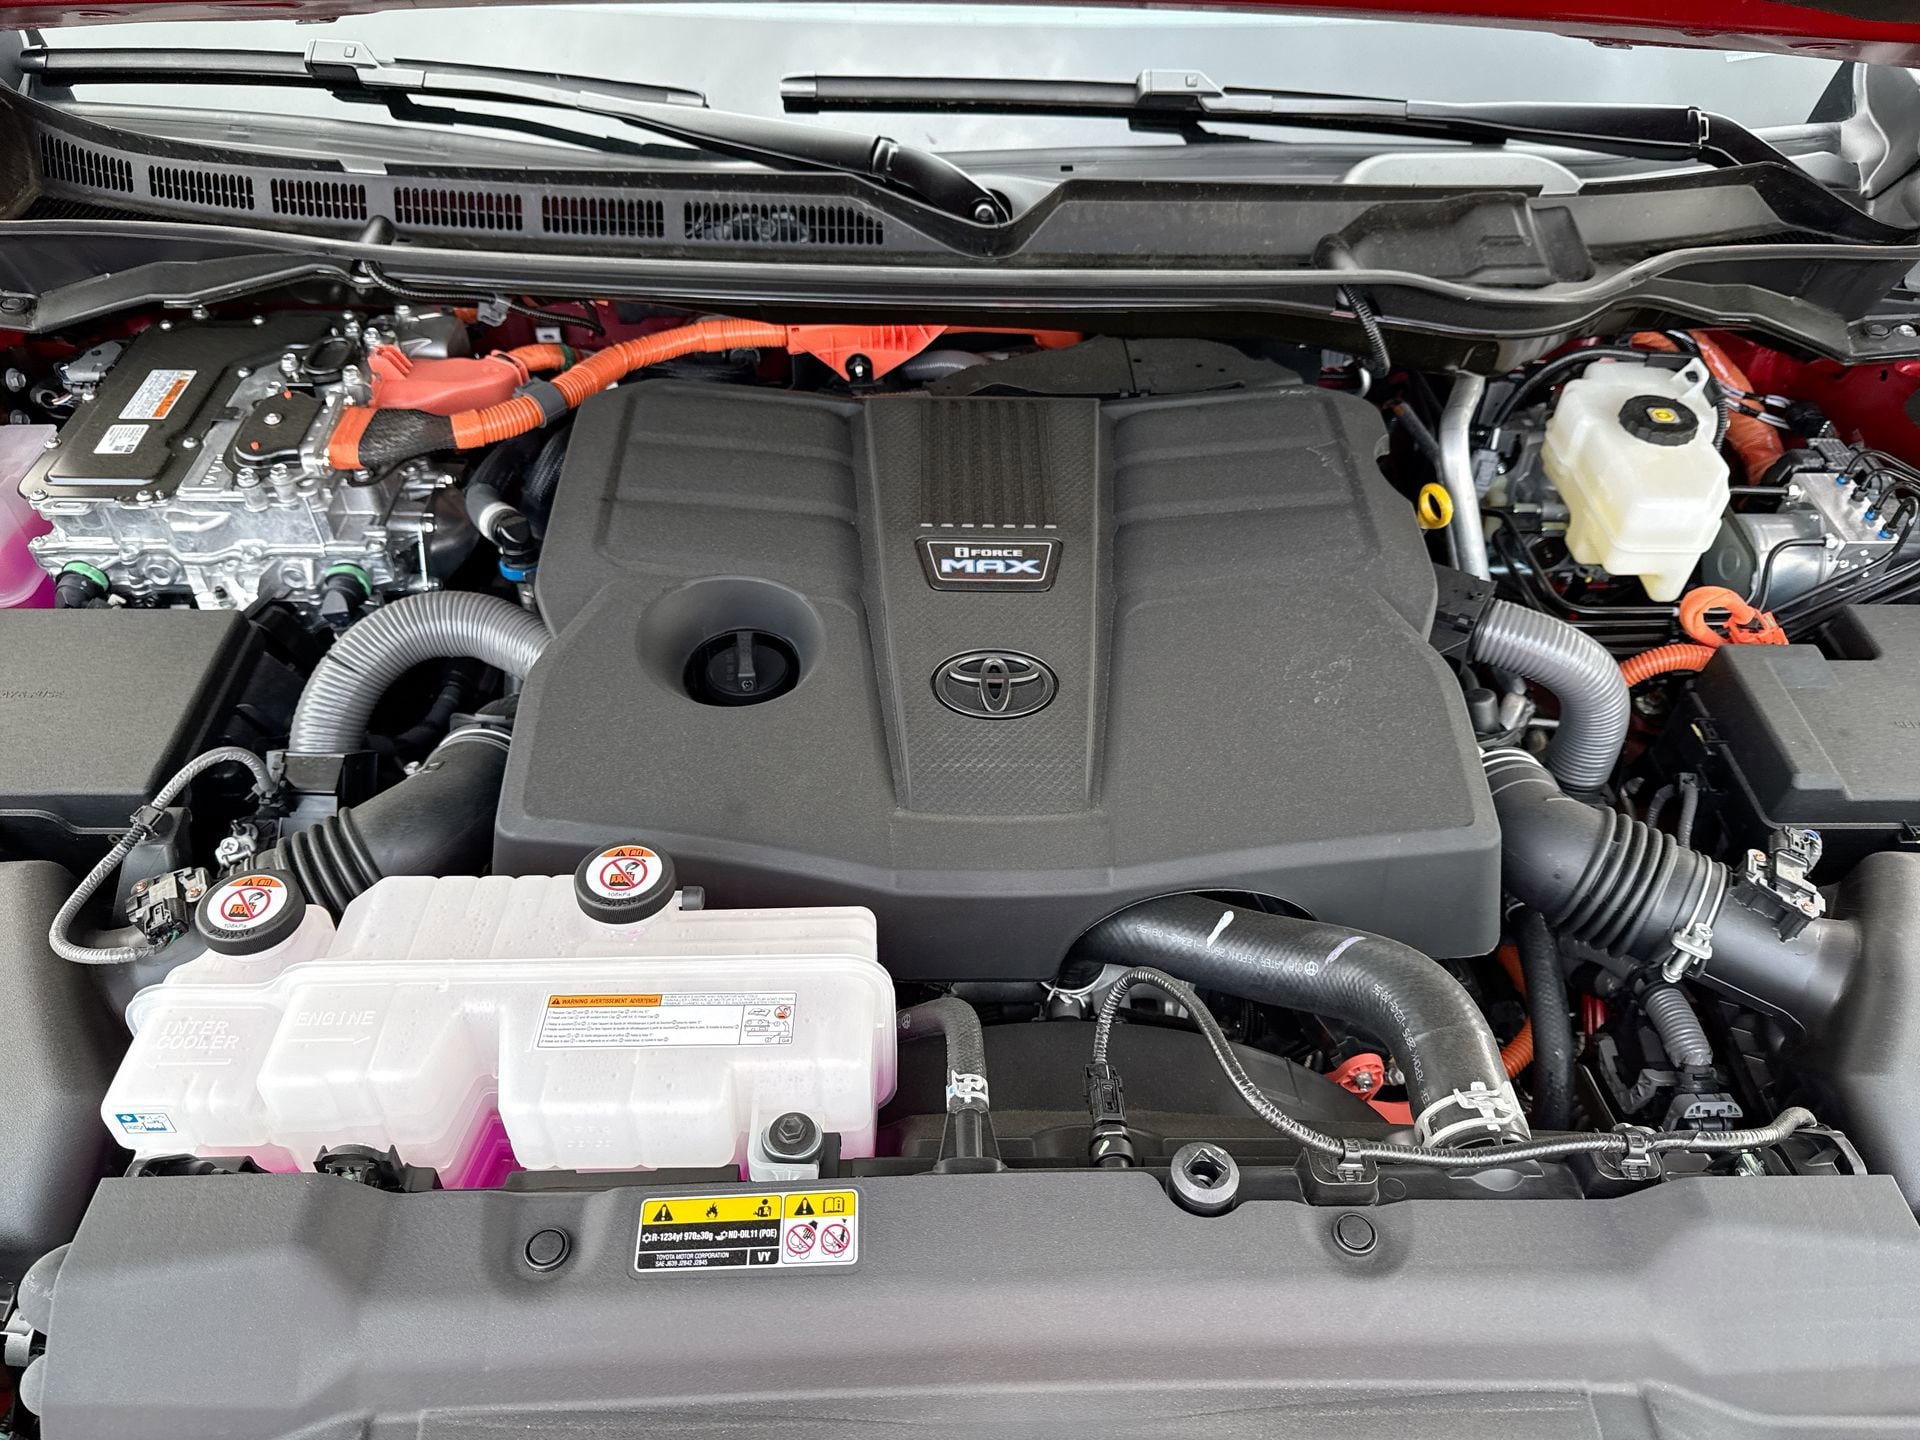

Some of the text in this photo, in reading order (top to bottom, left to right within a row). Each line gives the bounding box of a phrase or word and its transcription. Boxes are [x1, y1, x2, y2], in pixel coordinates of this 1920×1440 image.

[940, 559, 1041, 574] MAX
[207, 929, 256, 940] DENSO
[294, 1010, 377, 1026] ENGINE
[160, 1021, 229, 1036] INTER
[156, 1035, 240, 1050] COOLER
[757, 1251, 771, 1262] VY
